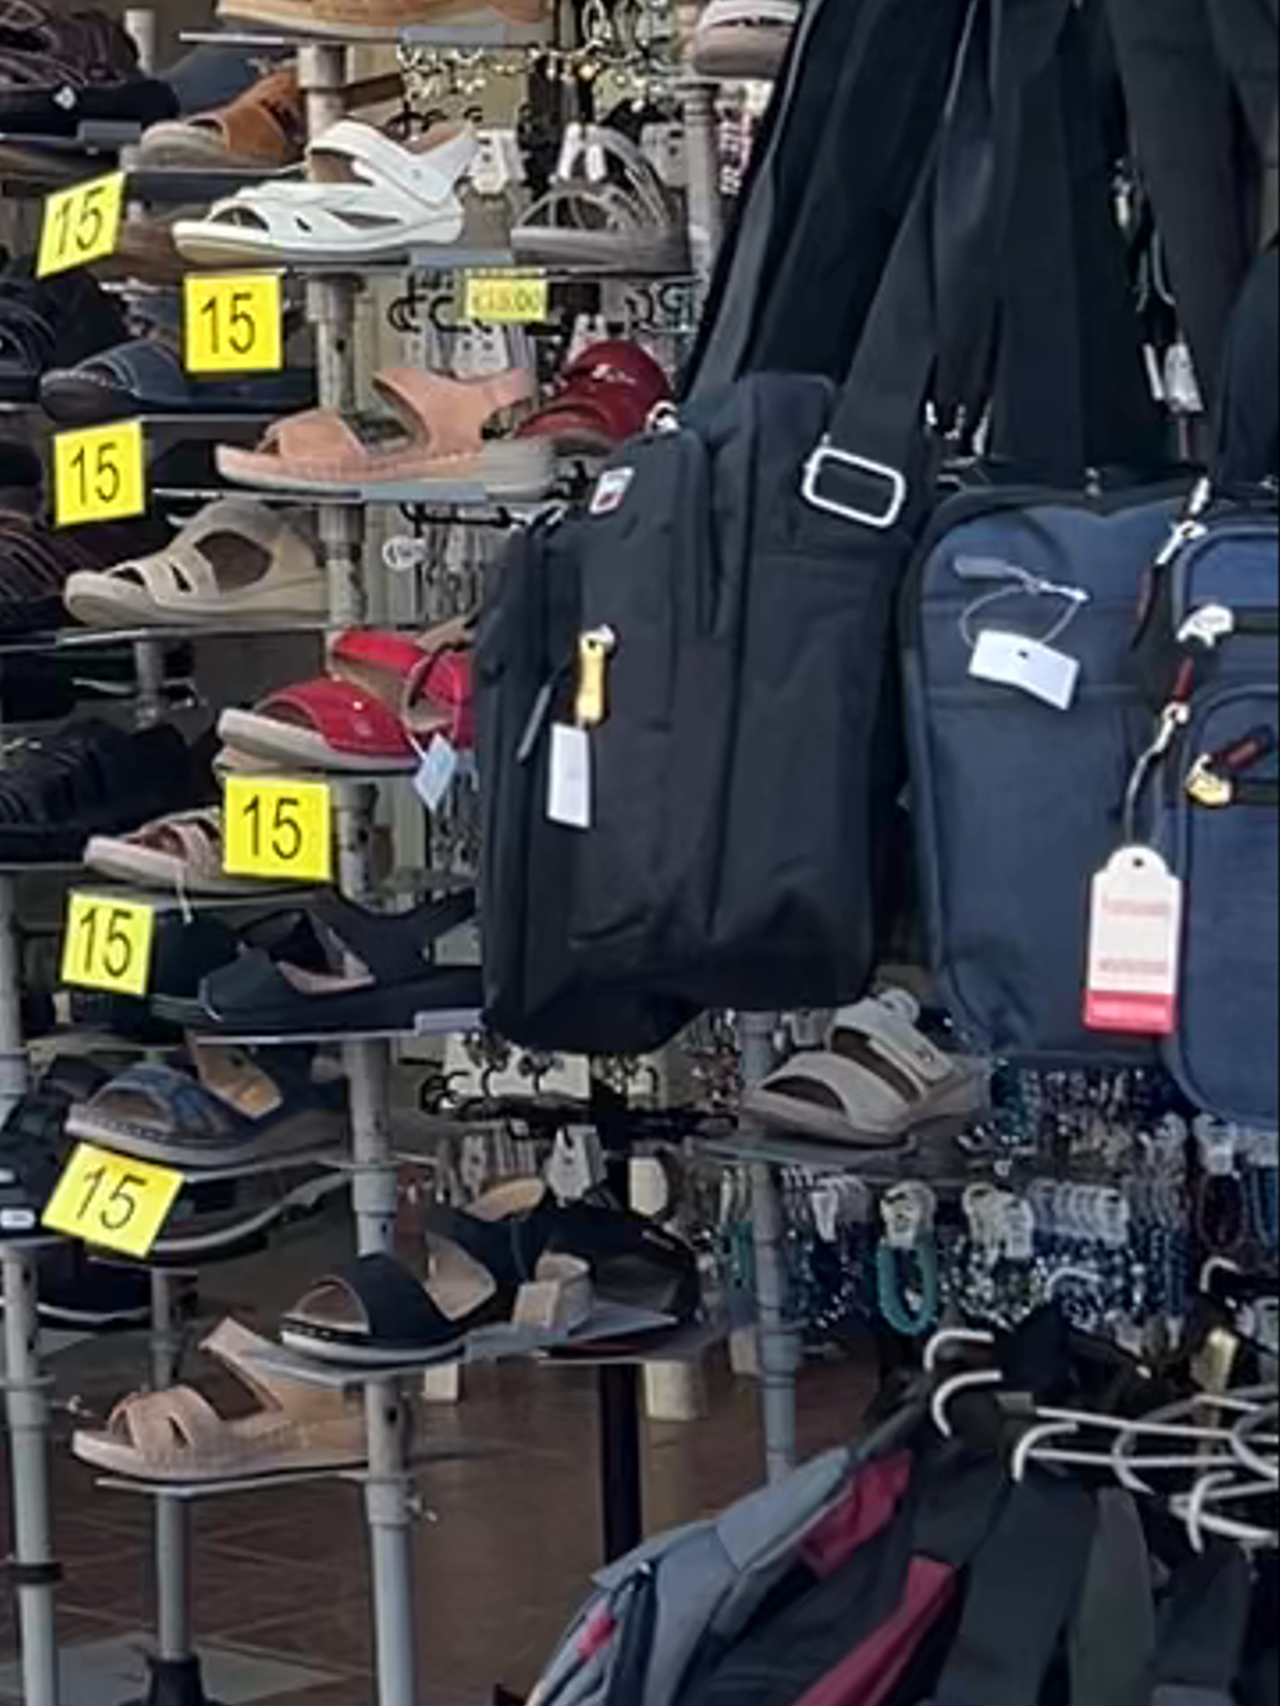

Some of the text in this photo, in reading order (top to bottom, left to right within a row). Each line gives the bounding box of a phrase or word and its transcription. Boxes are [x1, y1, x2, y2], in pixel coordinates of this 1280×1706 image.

[54, 188, 106, 256] 15
[201, 292, 256, 356] 15
[69, 443, 119, 504] 15
[242, 795, 303, 861] 15
[78, 907, 133, 979] 15
[78, 1165, 147, 1231] 15
